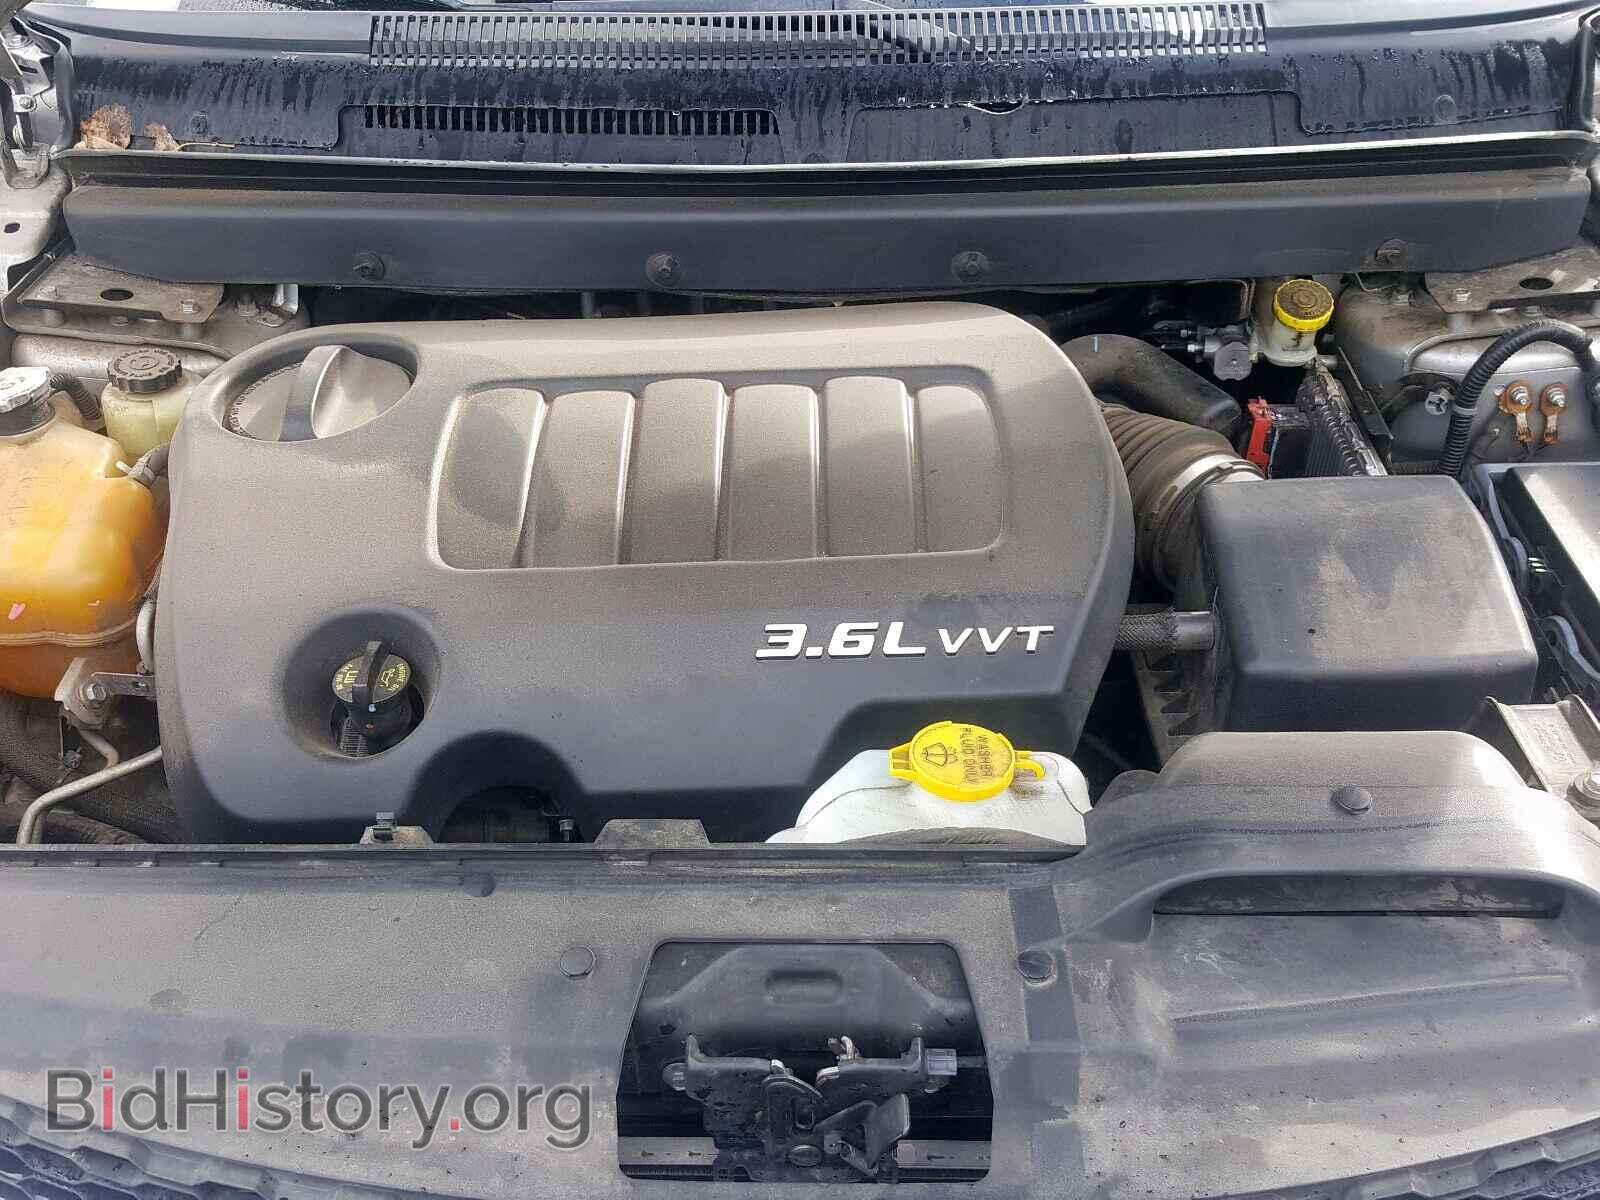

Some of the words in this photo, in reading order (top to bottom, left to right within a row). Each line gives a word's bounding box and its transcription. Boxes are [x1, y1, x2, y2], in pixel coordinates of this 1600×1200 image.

[755, 622, 926, 660] 3.6L
[938, 625, 1054, 655] VVT
[960, 728, 975, 755] FLUID
[976, 735, 992, 776] WASHER
[962, 758, 978, 784] ONLY
